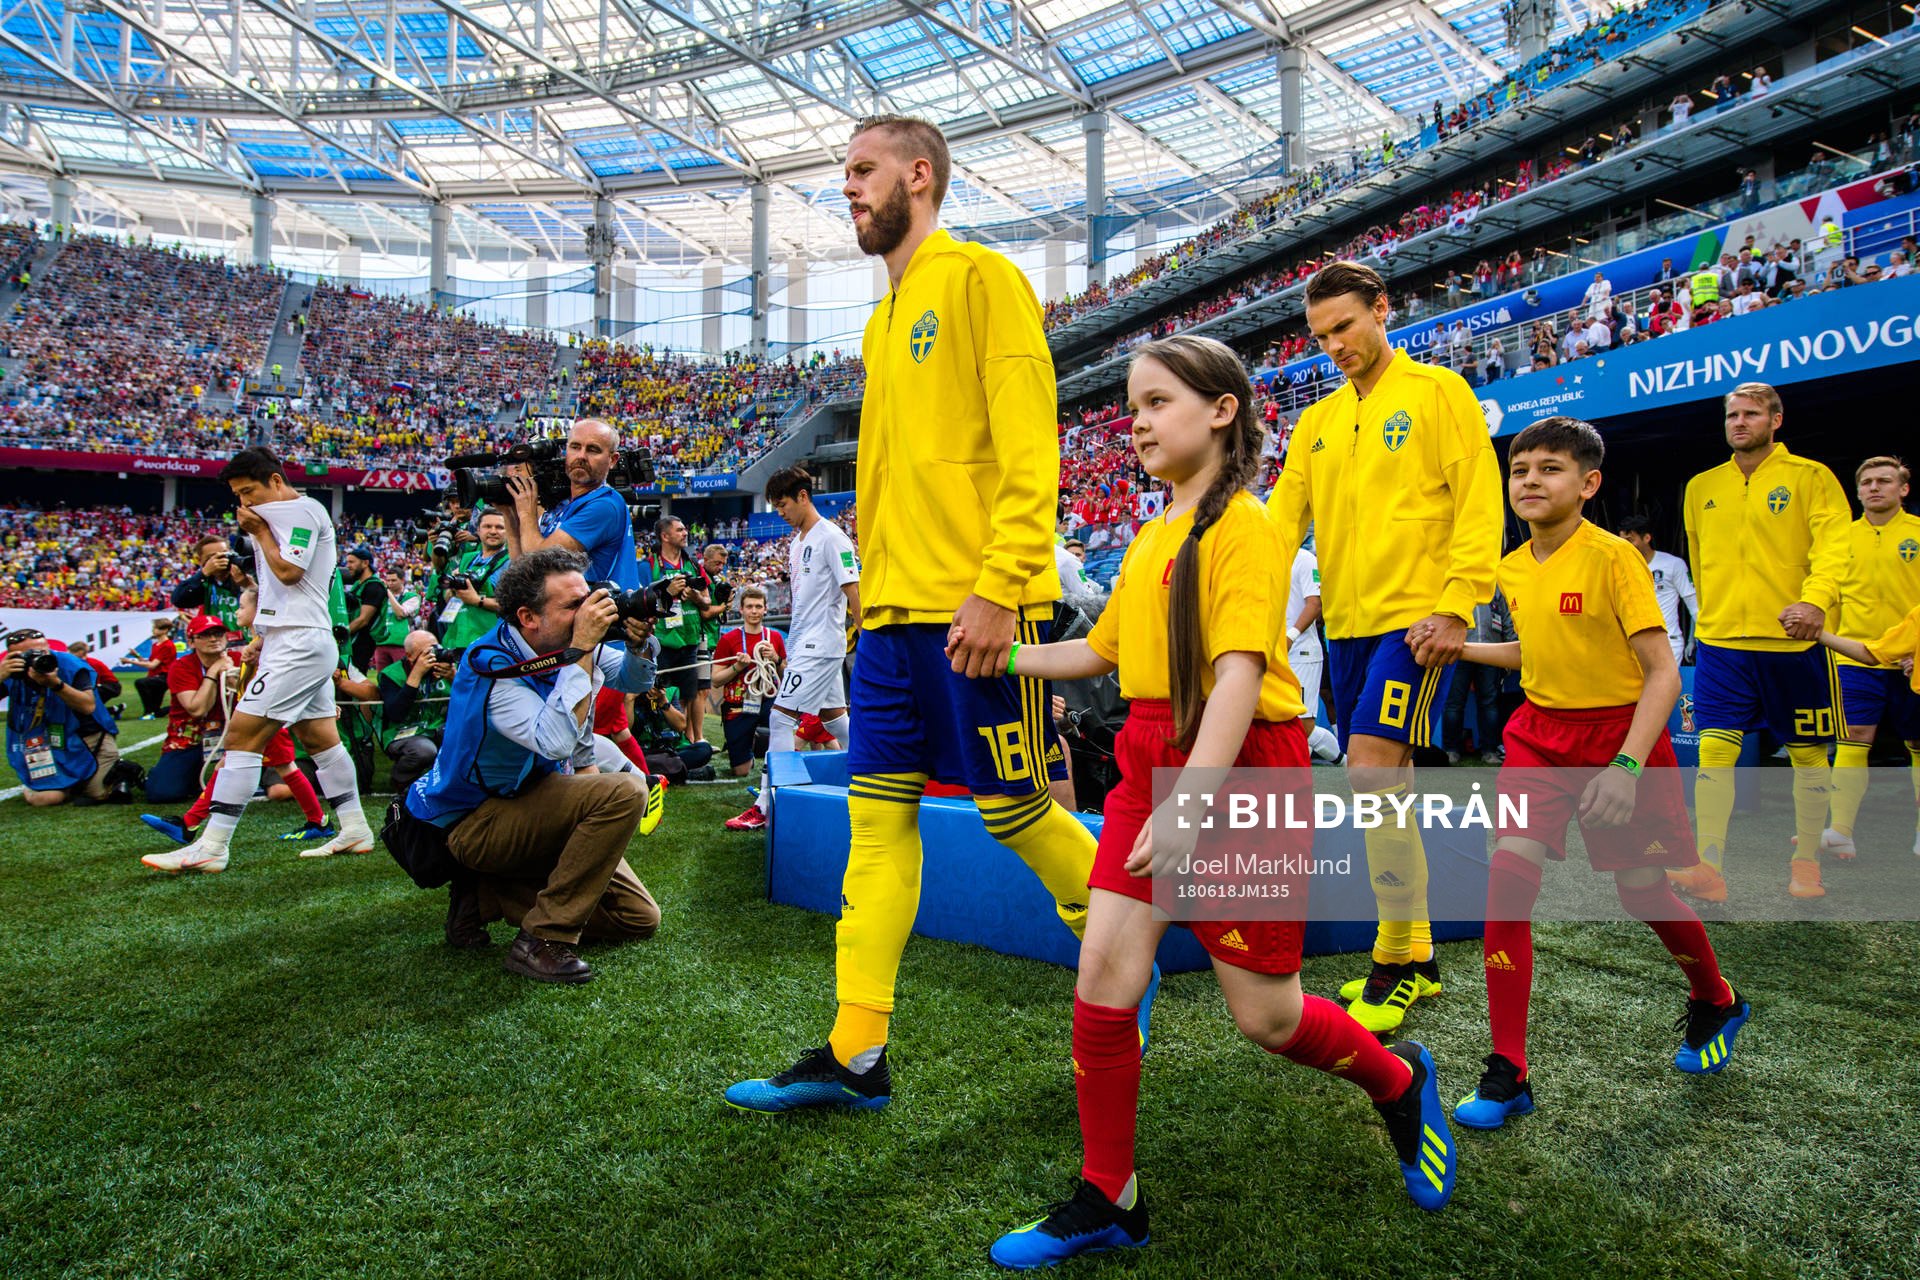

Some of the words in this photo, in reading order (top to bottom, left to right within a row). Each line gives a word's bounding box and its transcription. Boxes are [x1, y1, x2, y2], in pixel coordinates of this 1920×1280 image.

[1629, 343, 1771, 398] NIZHNY
[1780, 314, 1920, 369] NOVG
[1508, 399, 1539, 413] KOREA
[1540, 390, 1585, 407] REPUBLIC
[133, 459, 200, 473] #worldcup
[520, 656, 558, 673] Canon
[251, 671, 270, 695] 6
[783, 671, 802, 694] 19
[1378, 679, 1411, 729] 8
[1794, 706, 1835, 737] 20
[977, 720, 1031, 781] 18
[1219, 937, 1249, 952] adidas
